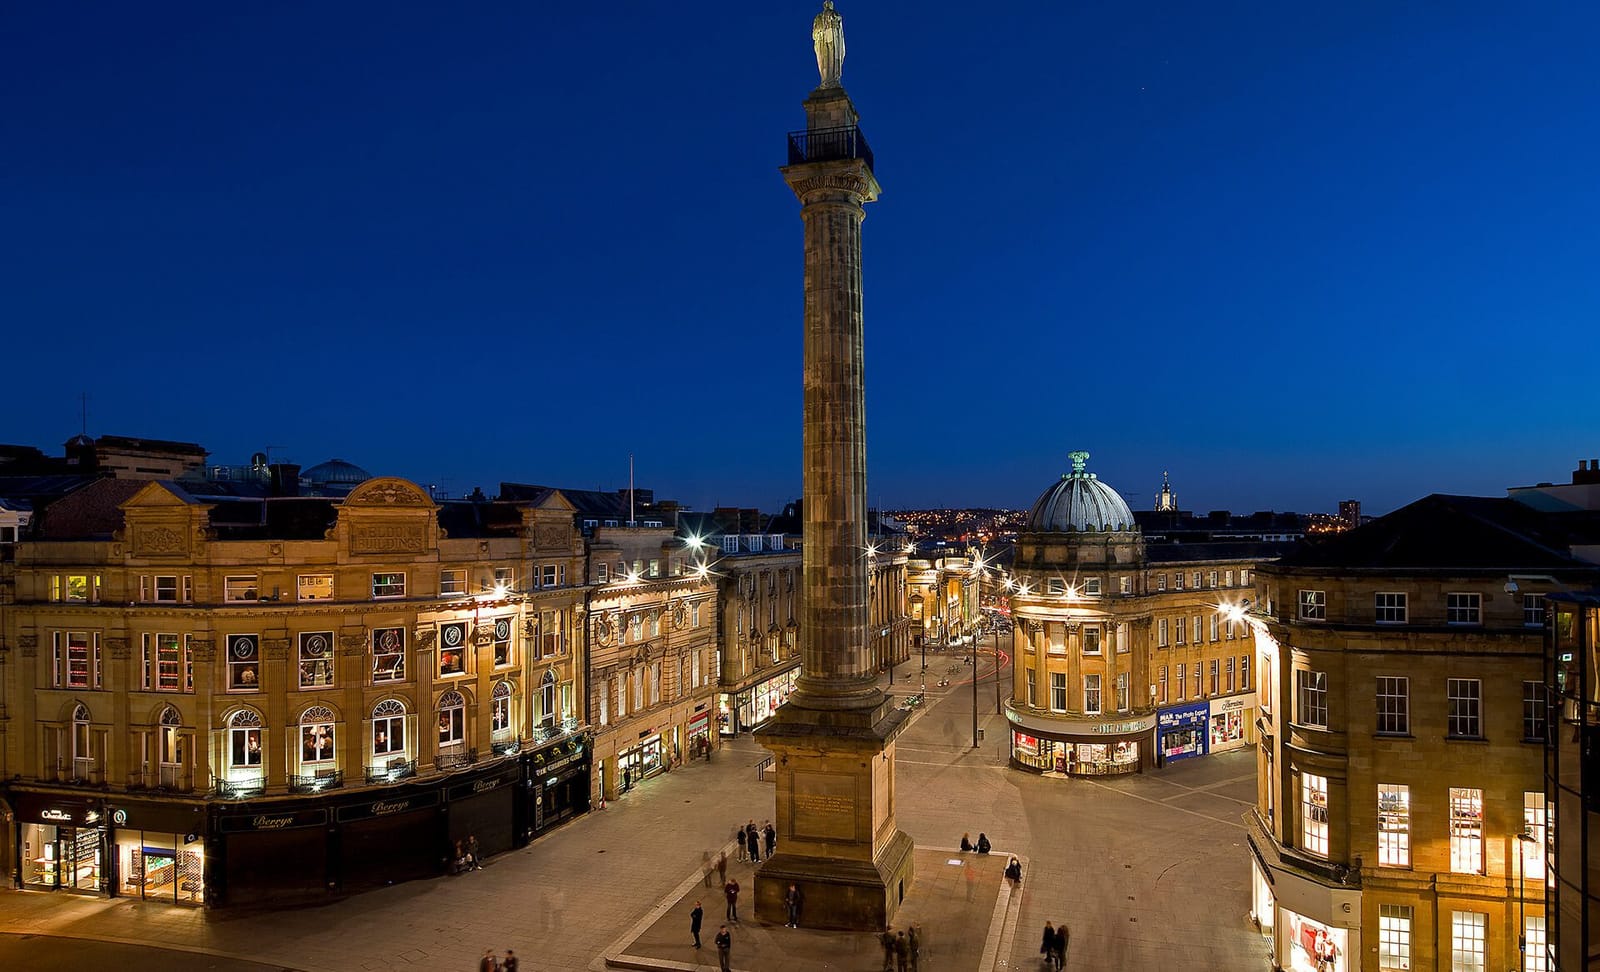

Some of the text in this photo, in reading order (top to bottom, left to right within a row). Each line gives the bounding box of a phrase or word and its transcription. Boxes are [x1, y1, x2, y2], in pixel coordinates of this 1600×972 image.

[359, 537, 422, 550] BUILDINGS
[371, 800, 409, 812] Berrys
[252, 815, 293, 828] Berrys
